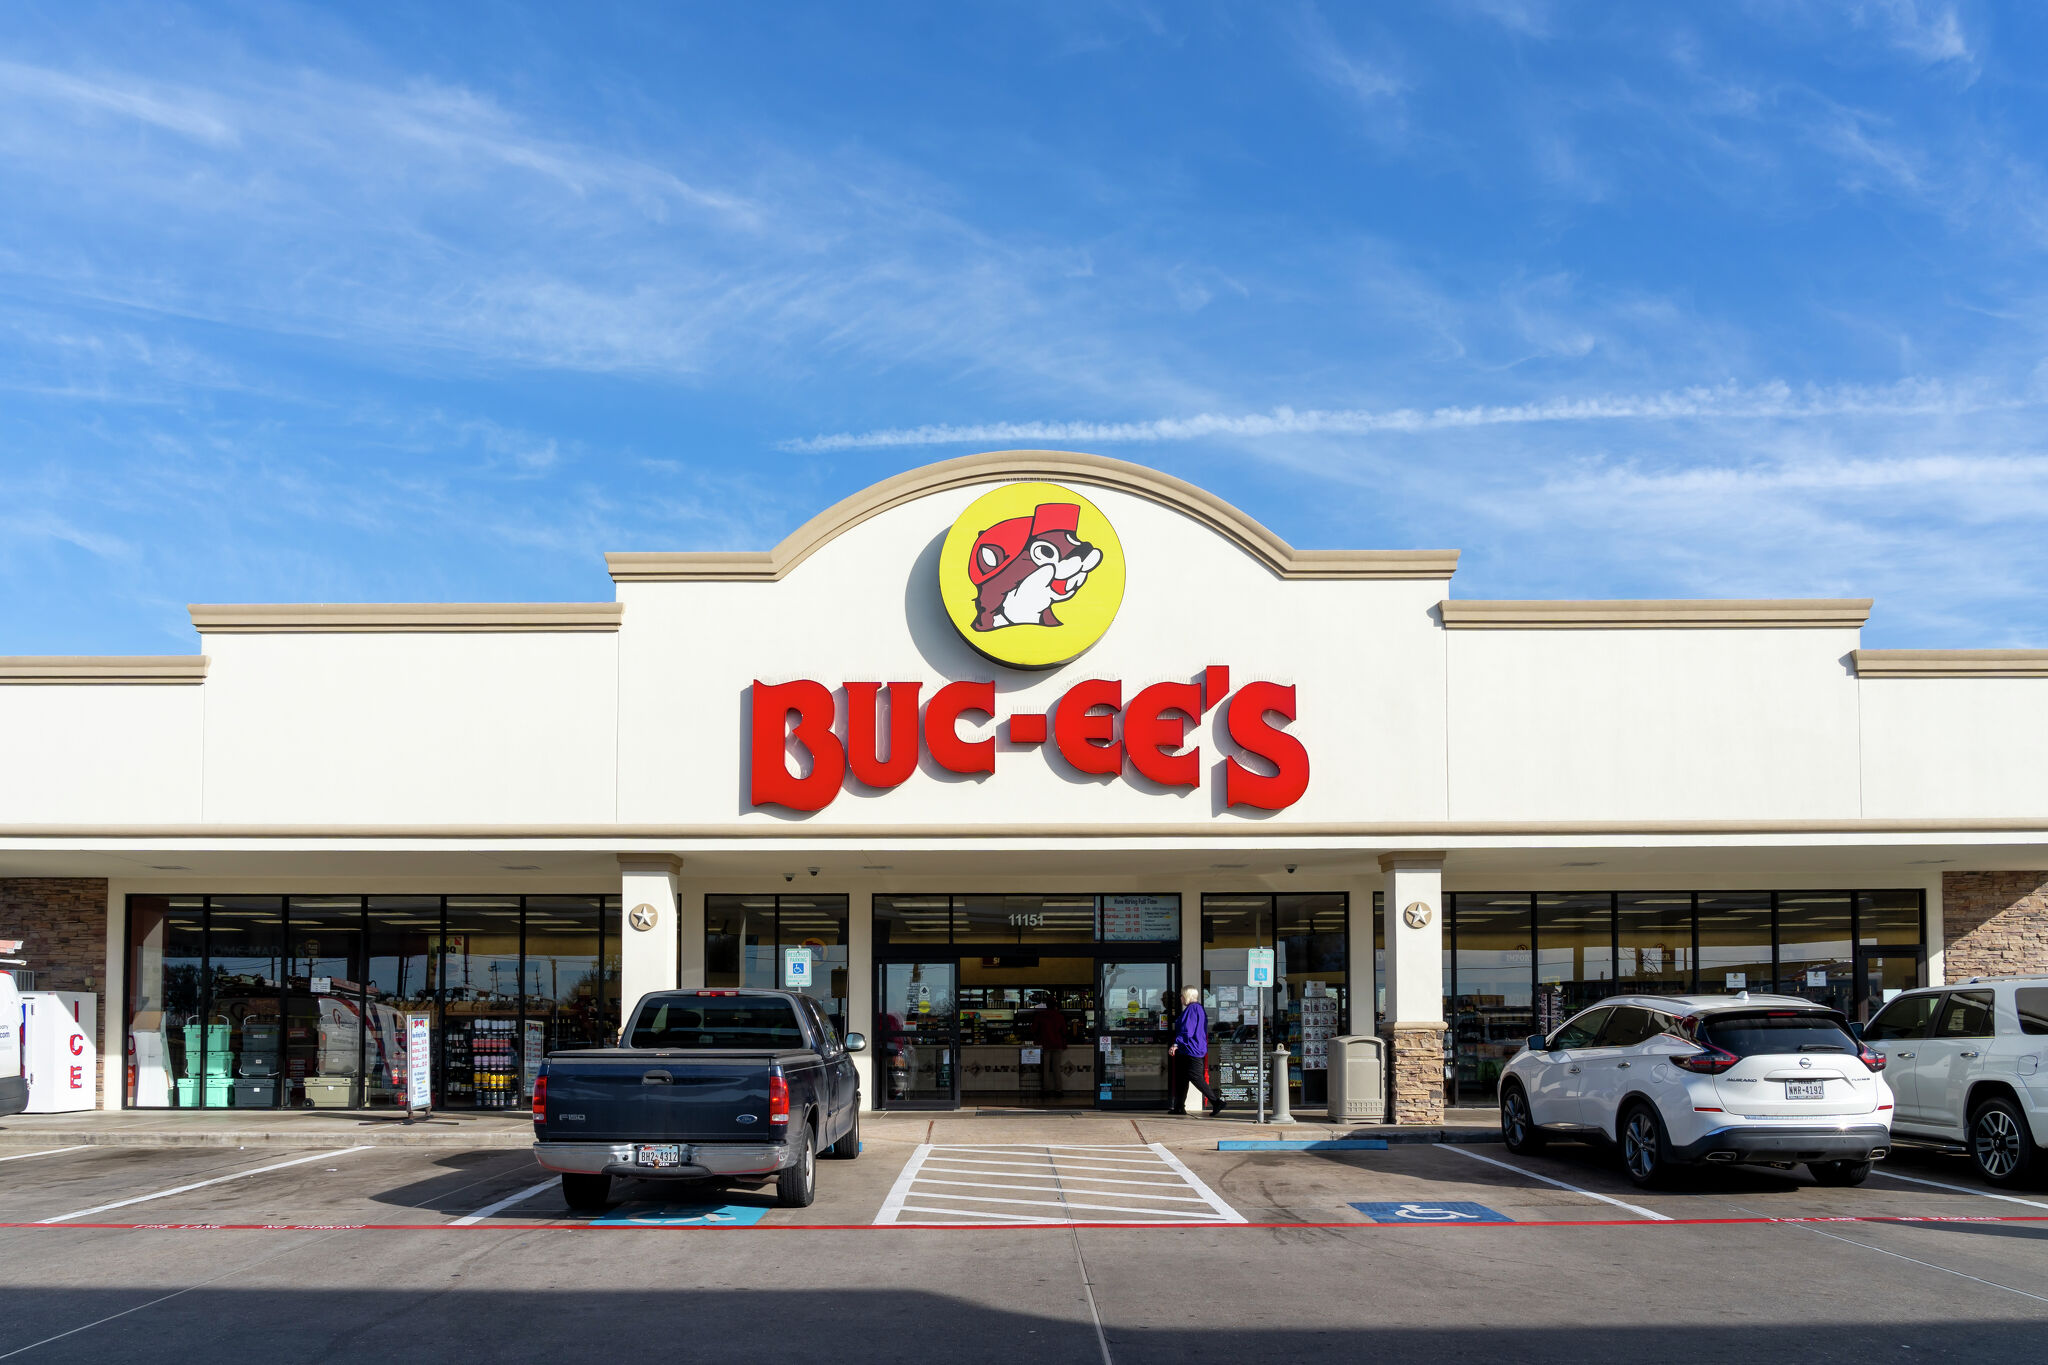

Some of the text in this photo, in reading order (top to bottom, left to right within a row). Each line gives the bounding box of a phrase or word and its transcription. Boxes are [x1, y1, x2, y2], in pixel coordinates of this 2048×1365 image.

[752, 665, 1310, 812] BUC-EE'S
[1008, 914, 1044, 926] 11151
[69, 1000, 84, 1090] ICE
